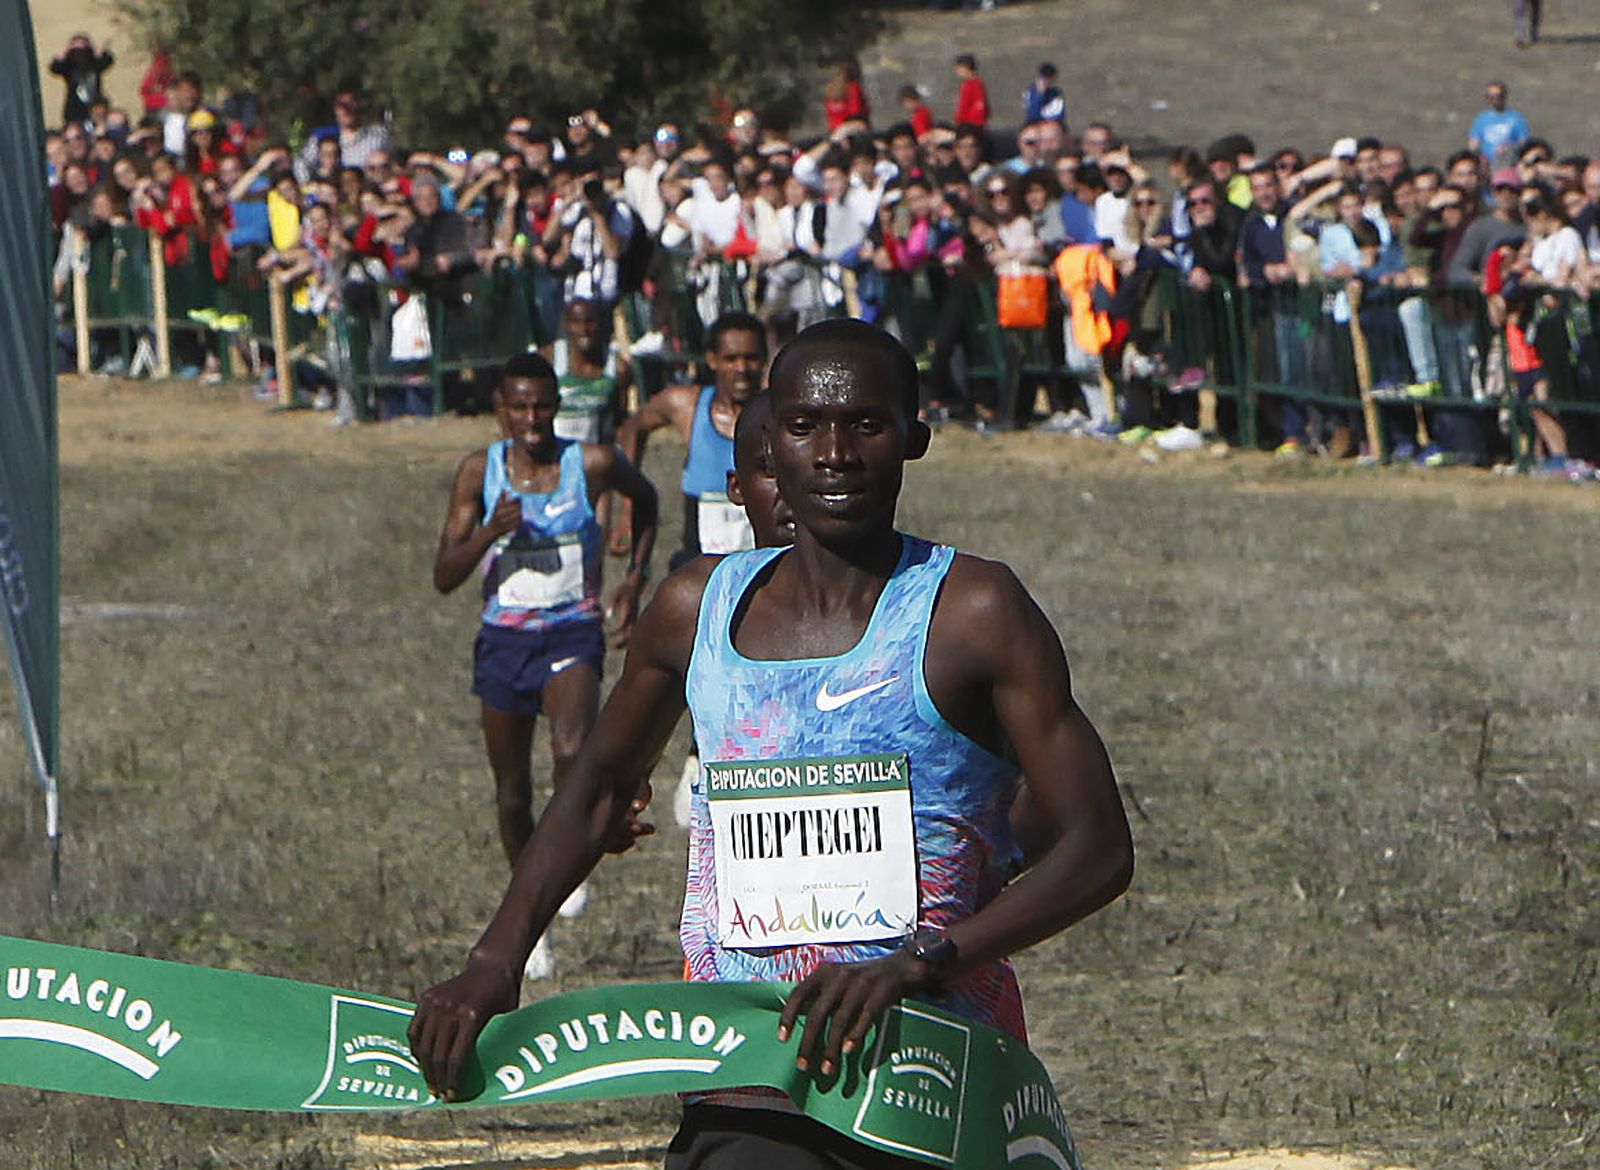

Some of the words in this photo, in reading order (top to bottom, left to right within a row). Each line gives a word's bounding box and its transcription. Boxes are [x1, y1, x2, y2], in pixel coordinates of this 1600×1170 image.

[711, 766, 801, 791] DIPUTACION
[806, 765, 830, 786] DE
[833, 760, 901, 785] SEVILLA
[729, 889, 898, 941] Andalucía
[494, 1009, 747, 1093] DIPUTACION
[337, 1077, 419, 1102] SEVILLA
[882, 1087, 951, 1120] SEVILLA
